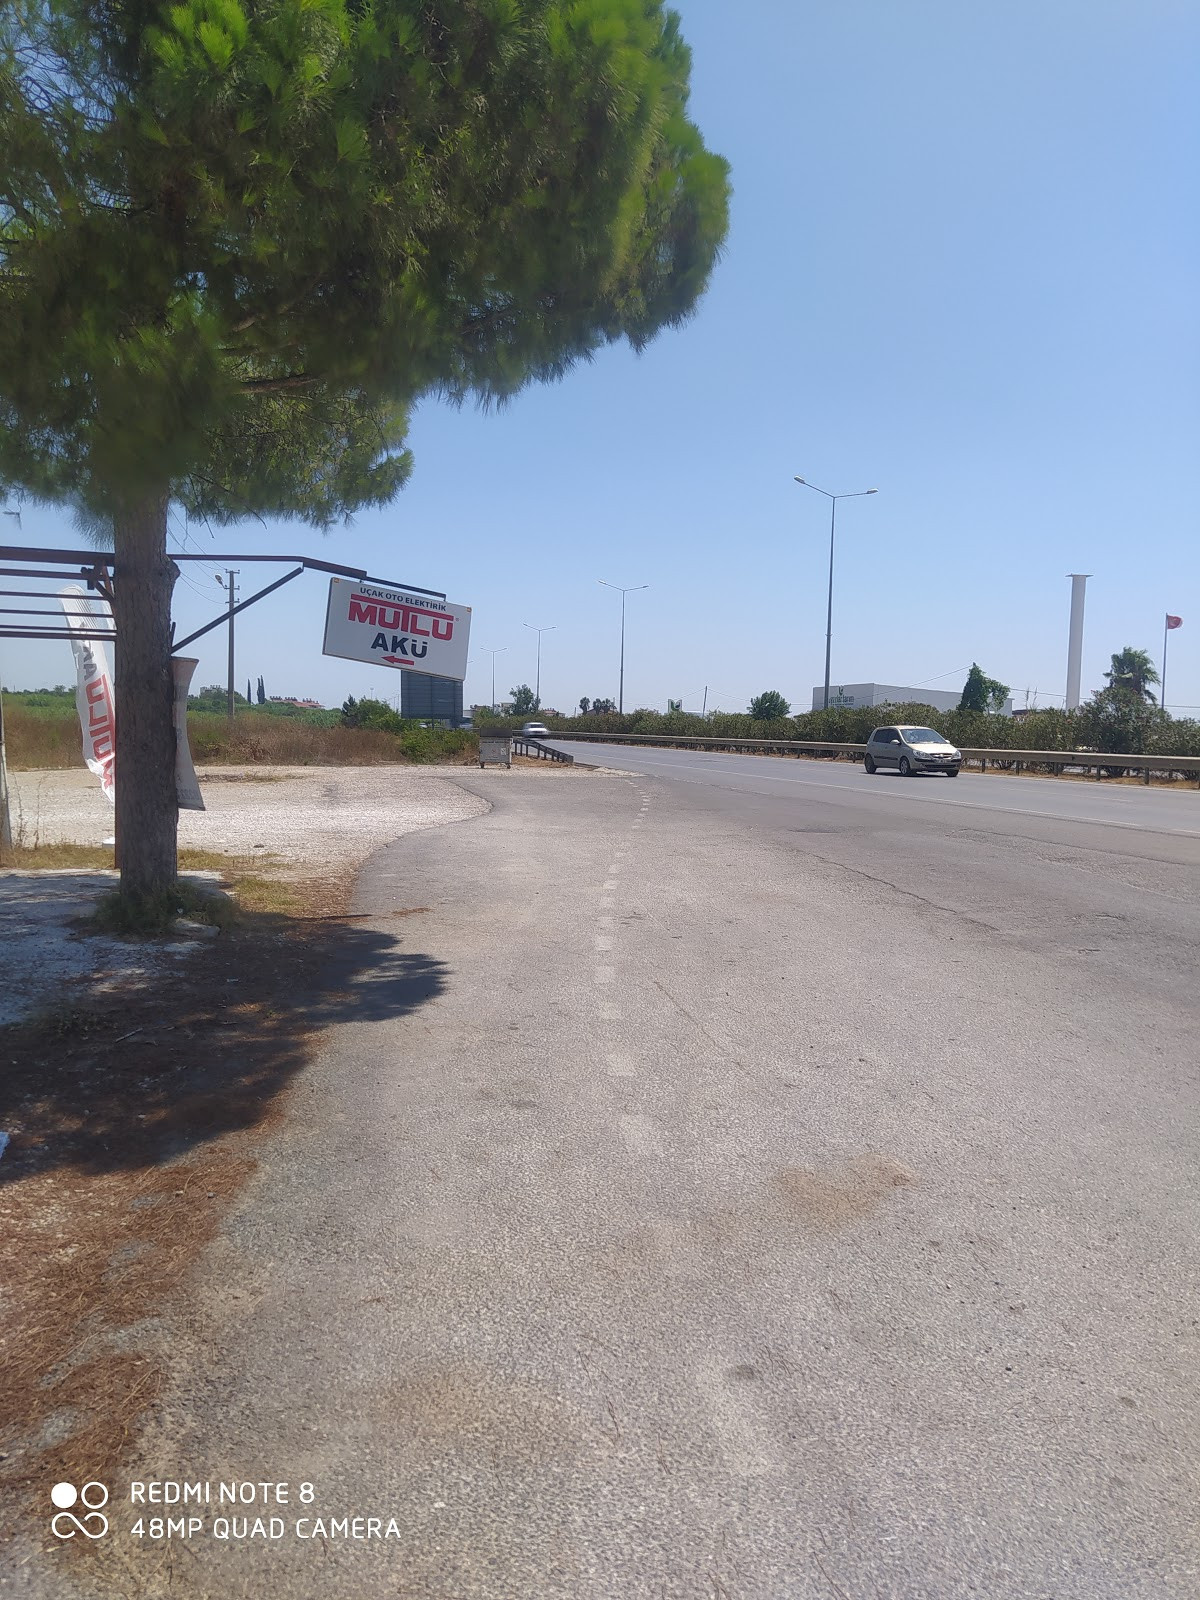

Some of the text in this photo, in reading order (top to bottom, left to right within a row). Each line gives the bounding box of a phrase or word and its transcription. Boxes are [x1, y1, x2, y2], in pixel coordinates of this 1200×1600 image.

[360, 587, 447, 611] UÇAK OTO ELEKTİRİK
[348, 593, 454, 641] MUTLU
[370, 632, 428, 659] AKÜ
